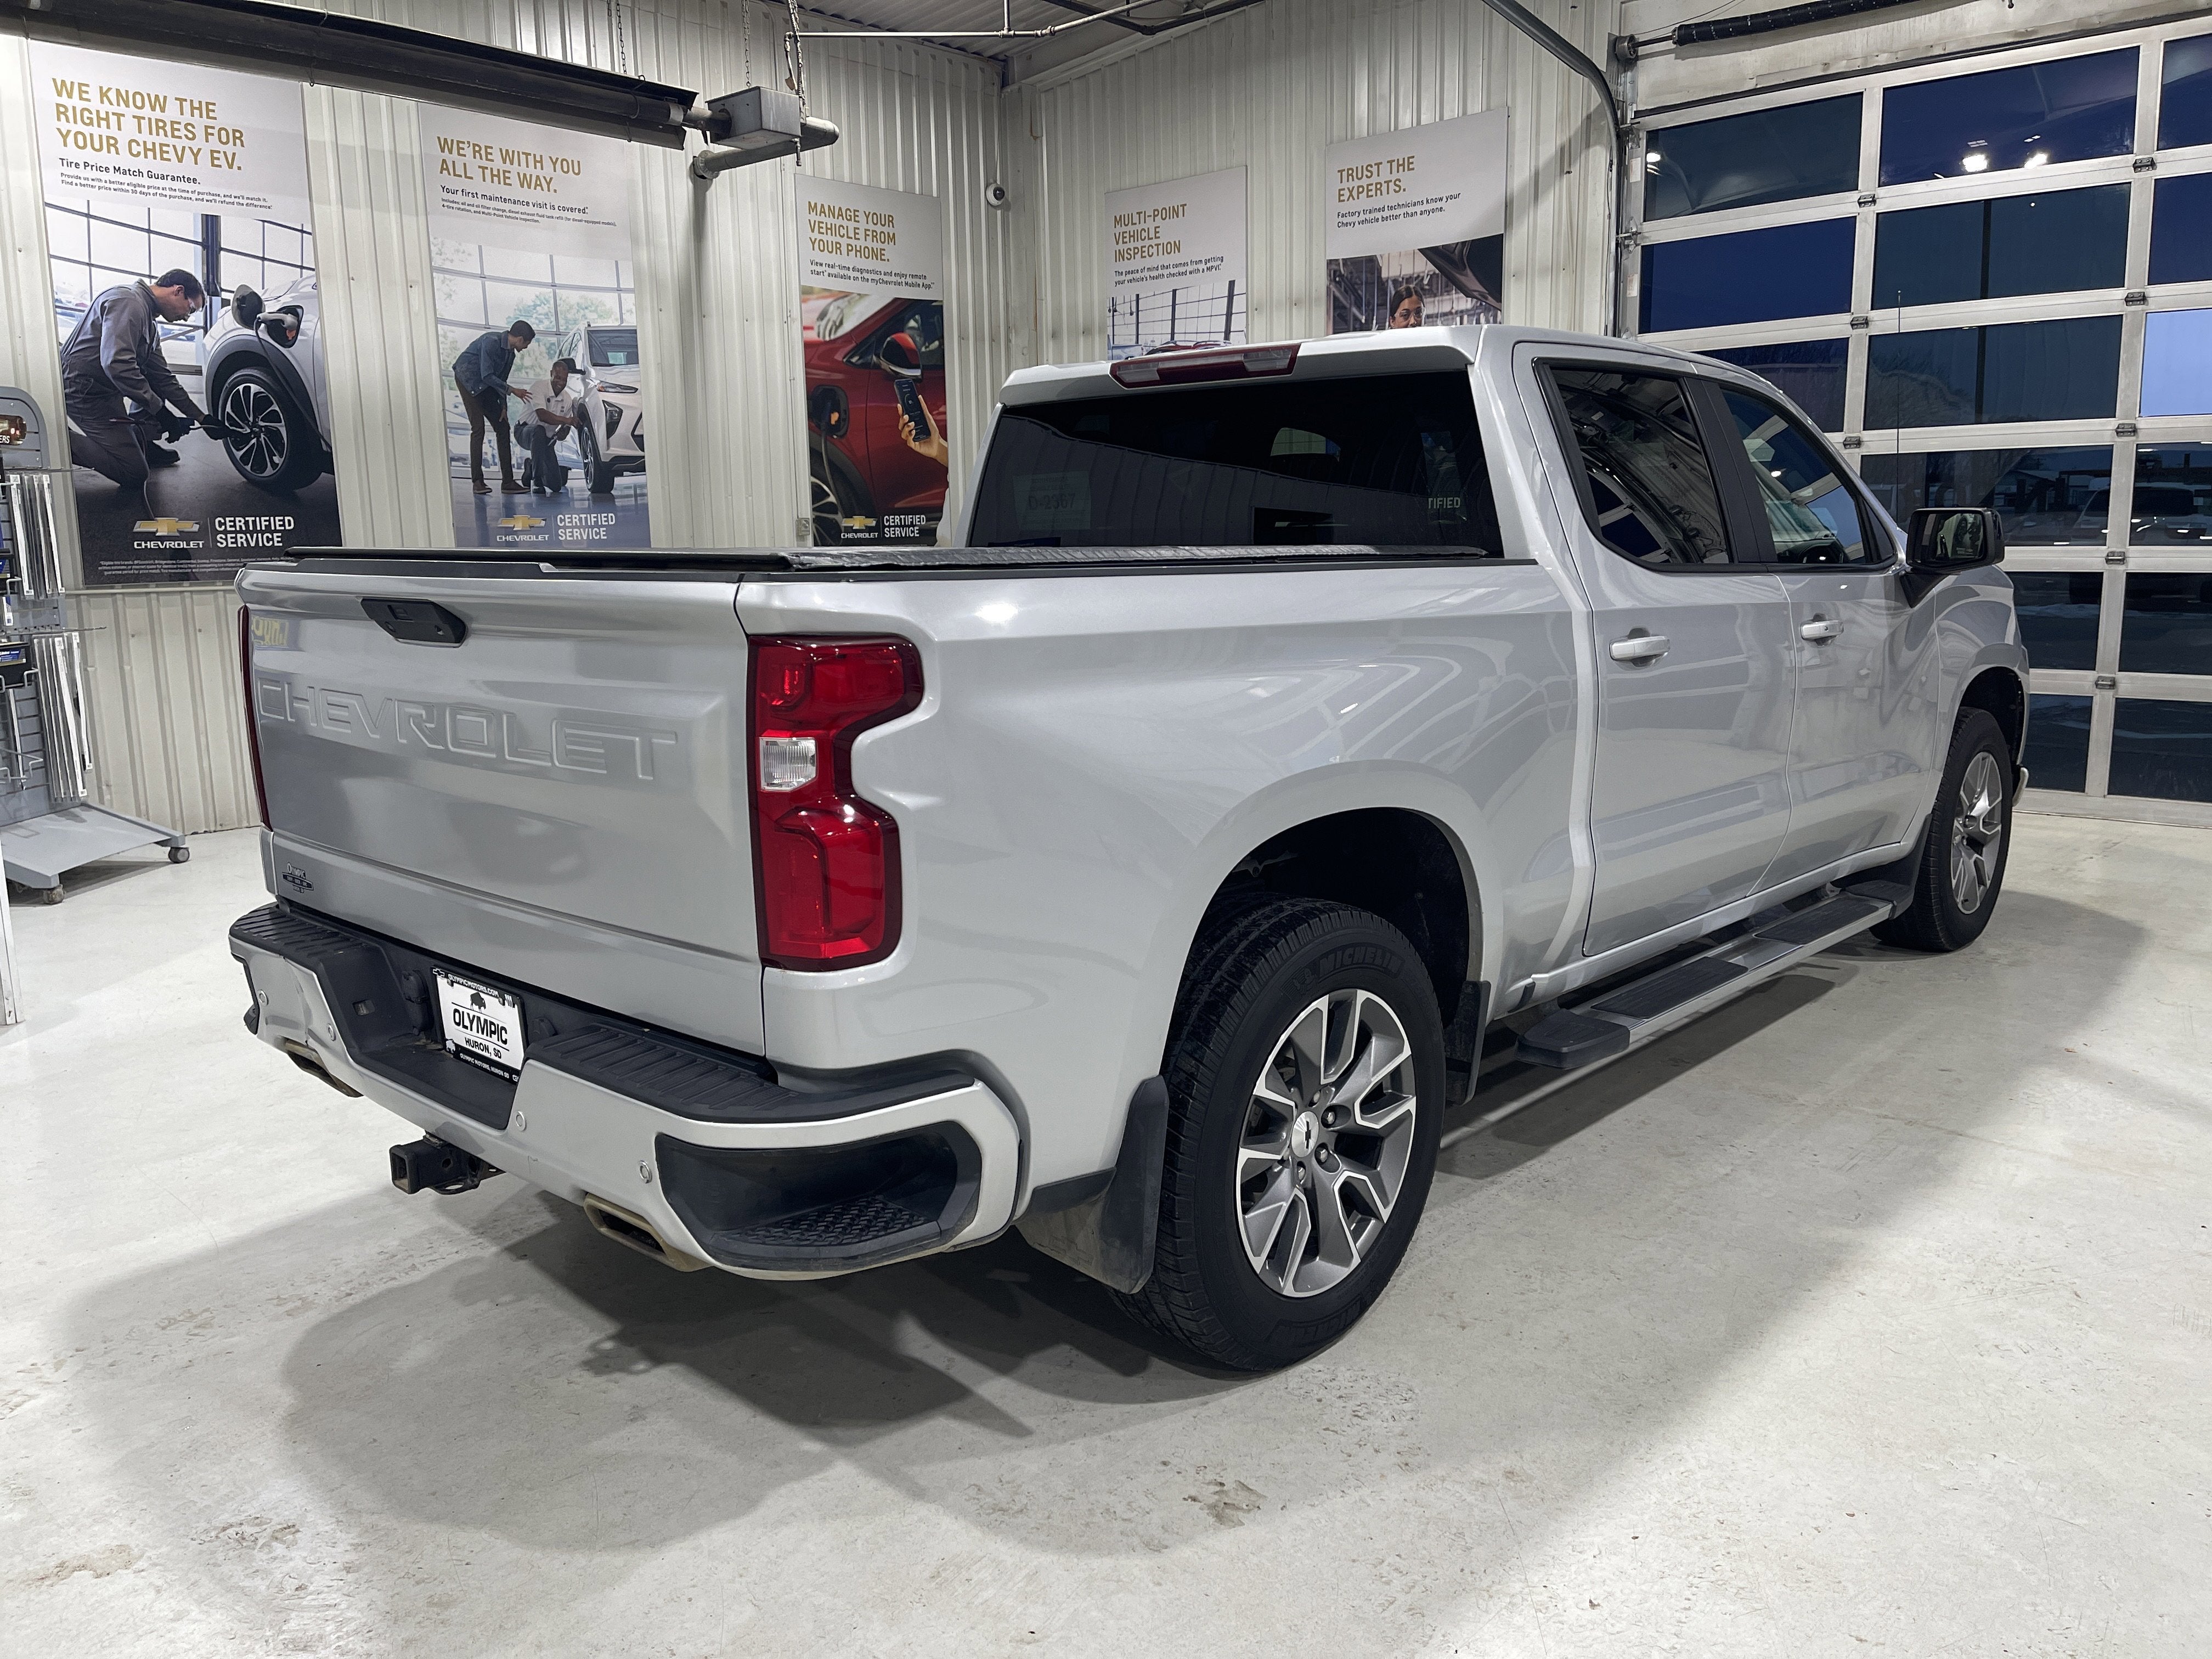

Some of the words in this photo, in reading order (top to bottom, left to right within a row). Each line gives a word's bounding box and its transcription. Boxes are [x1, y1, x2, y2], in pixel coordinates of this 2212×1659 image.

[52, 77, 91, 102] WE
[99, 86, 167, 113] KNOW
[174, 97, 217, 120] THE
[55, 103, 125, 131] RIGHT
[132, 115, 196, 140] TIRES
[204, 125, 245, 148] FOR
[56, 127, 120, 155] YOUR
[128, 139, 202, 165] CHEVY
[210, 149, 241, 171] EV.
[436, 136, 494, 162] WE'RE
[499, 148, 543, 170] WITH
[548, 156, 580, 176] YOU
[59, 157, 80, 168] Tire
[83, 161, 109, 173] Price
[113, 165, 143, 177] Match
[146, 170, 200, 184] Guarantee.
[439, 158, 473, 180] ALL
[478, 165, 512, 186] THE
[516, 171, 557, 193] WAY.
[1337, 161, 1383, 184] TRUST
[1386, 155, 1414, 174] THE
[440, 184, 459, 195] Your
[461, 188, 478, 199] first
[481, 194, 529, 206] maintenance
[531, 201, 548, 209] visit
[549, 202, 555, 210] is
[1338, 178, 1406, 202] EXPERTS.
[808, 201, 860, 223] MANAGE
[863, 210, 894, 228] YOUR
[1114, 203, 1187, 228] MULTI-POINT
[1337, 210, 1361, 218] Factory
[1362, 205, 1385, 215] trained
[1387, 200, 1424, 211] technicians
[1426, 196, 1443, 204] know
[1444, 193, 1460, 202] your
[1357, 216, 1379, 225] vehicle
[1381, 213, 1401, 222] better
[1419, 206, 1444, 216] anyone.
[808, 219, 860, 240] VEHICLE
[864, 228, 895, 245] FROM
[1114, 225, 1160, 245] VEHICLE
[809, 236, 842, 255] YOUR
[846, 243, 889, 262] PHONE.
[1114, 239, 1180, 262] INSPECTION
[825, 262, 850, 271] real-time
[851, 266, 882, 275] diagnostics
[894, 271, 907, 279] enjoy
[1114, 279, 1126, 287] your
[1126, 275, 1148, 283] vehicle's
[1149, 272, 1165, 280] health
[1166, 269, 1187, 278] checked
[1125, 268, 1139, 276] peace
[1147, 264, 1159, 272] mind
[1204, 256, 1223, 265] getting
[871, 278, 903, 286] myChevrolet
[215, 516, 295, 531] CERTIFIED
[557, 513, 616, 527] CERTIFIED
[884, 515, 926, 526] CERTIFIED
[134, 540, 204, 549] CHEVROLET
[216, 533, 283, 548] SERVICE
[558, 527, 607, 540] SERVICE
[884, 527, 919, 538] SERVICE
[257, 676, 678, 780] CHEVROLET
[1319, 946, 1401, 977] MICHELIN
[453, 1008, 507, 1045] OLYMPIC
[465, 1037, 492, 1057] HURON,
[493, 1047, 501, 1059] SD
